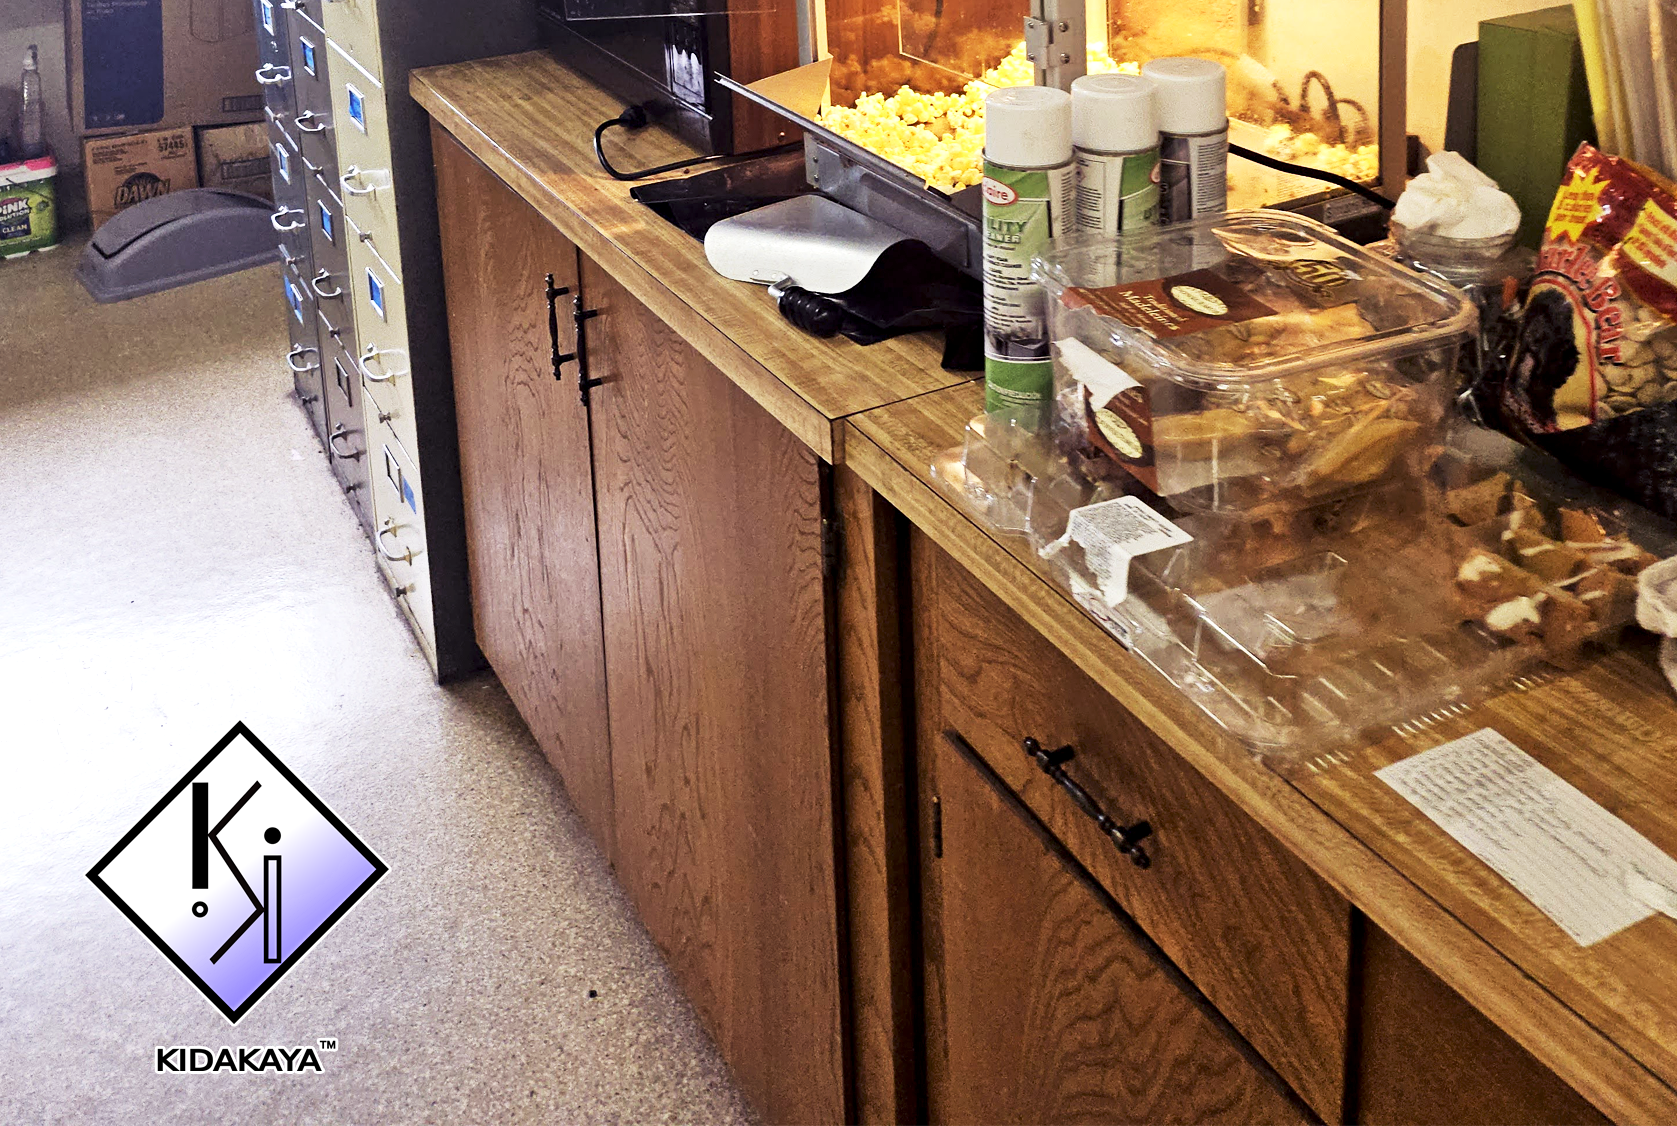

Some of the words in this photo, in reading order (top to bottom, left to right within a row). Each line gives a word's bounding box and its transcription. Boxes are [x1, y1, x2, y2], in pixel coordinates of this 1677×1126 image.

[114, 178, 171, 209] DAWN
[984, 183, 1009, 201] laire
[0, 208, 30, 222] OLUTION
[2, 223, 28, 234] CLEAN
